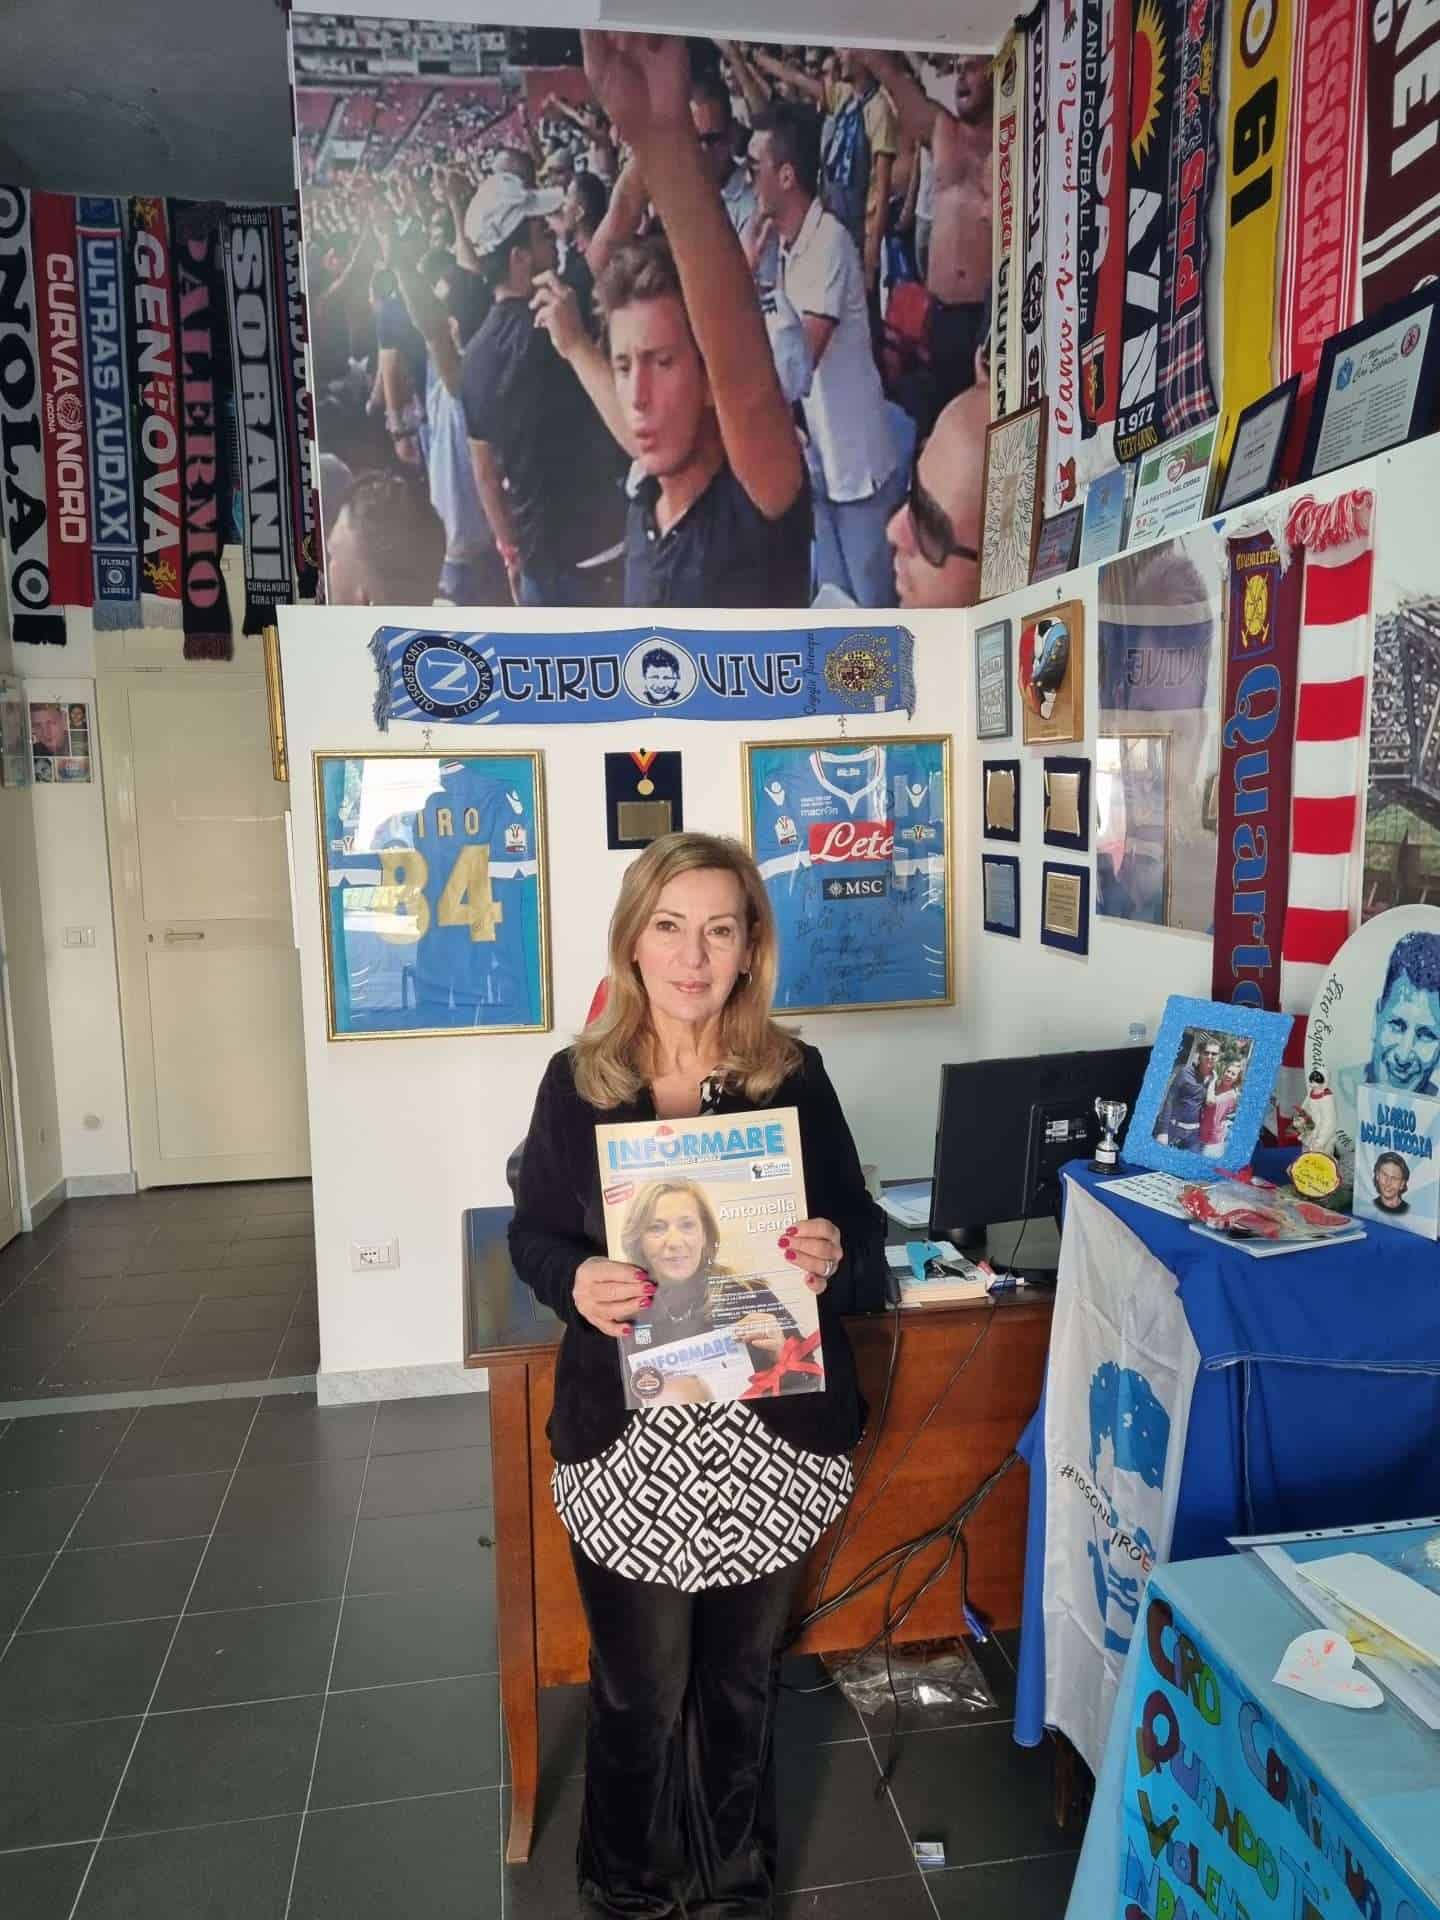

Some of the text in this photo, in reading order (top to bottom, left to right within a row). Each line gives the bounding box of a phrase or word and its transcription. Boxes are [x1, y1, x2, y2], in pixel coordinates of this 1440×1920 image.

[1085, 20, 1097, 81] AND
[1026, 22, 1047, 251] Trapan
[1079, 91, 1096, 241] FOOTBALL
[1079, 256, 1089, 324] CLUB
[46, 253, 87, 544] CURVA NORD
[46, 392, 56, 434] ANCONA
[85, 239, 130, 540] ULTRAS AUDAX
[231, 226, 282, 580] SORANI
[1117, 402, 1156, 436] 1977
[178, 236, 219, 608] PALERMO
[403, 664, 435, 711] ESPOSITO
[447, 640, 492, 715] CLUB NAPOLI
[498, 652, 802, 702] CIRO VIVE
[811, 822, 895, 862] Lete
[377, 844, 502, 945] 84
[845, 880, 883, 896] MSC
[608, 1123, 785, 1169] INFORMARE
[719, 1199, 796, 1220] Antonella
